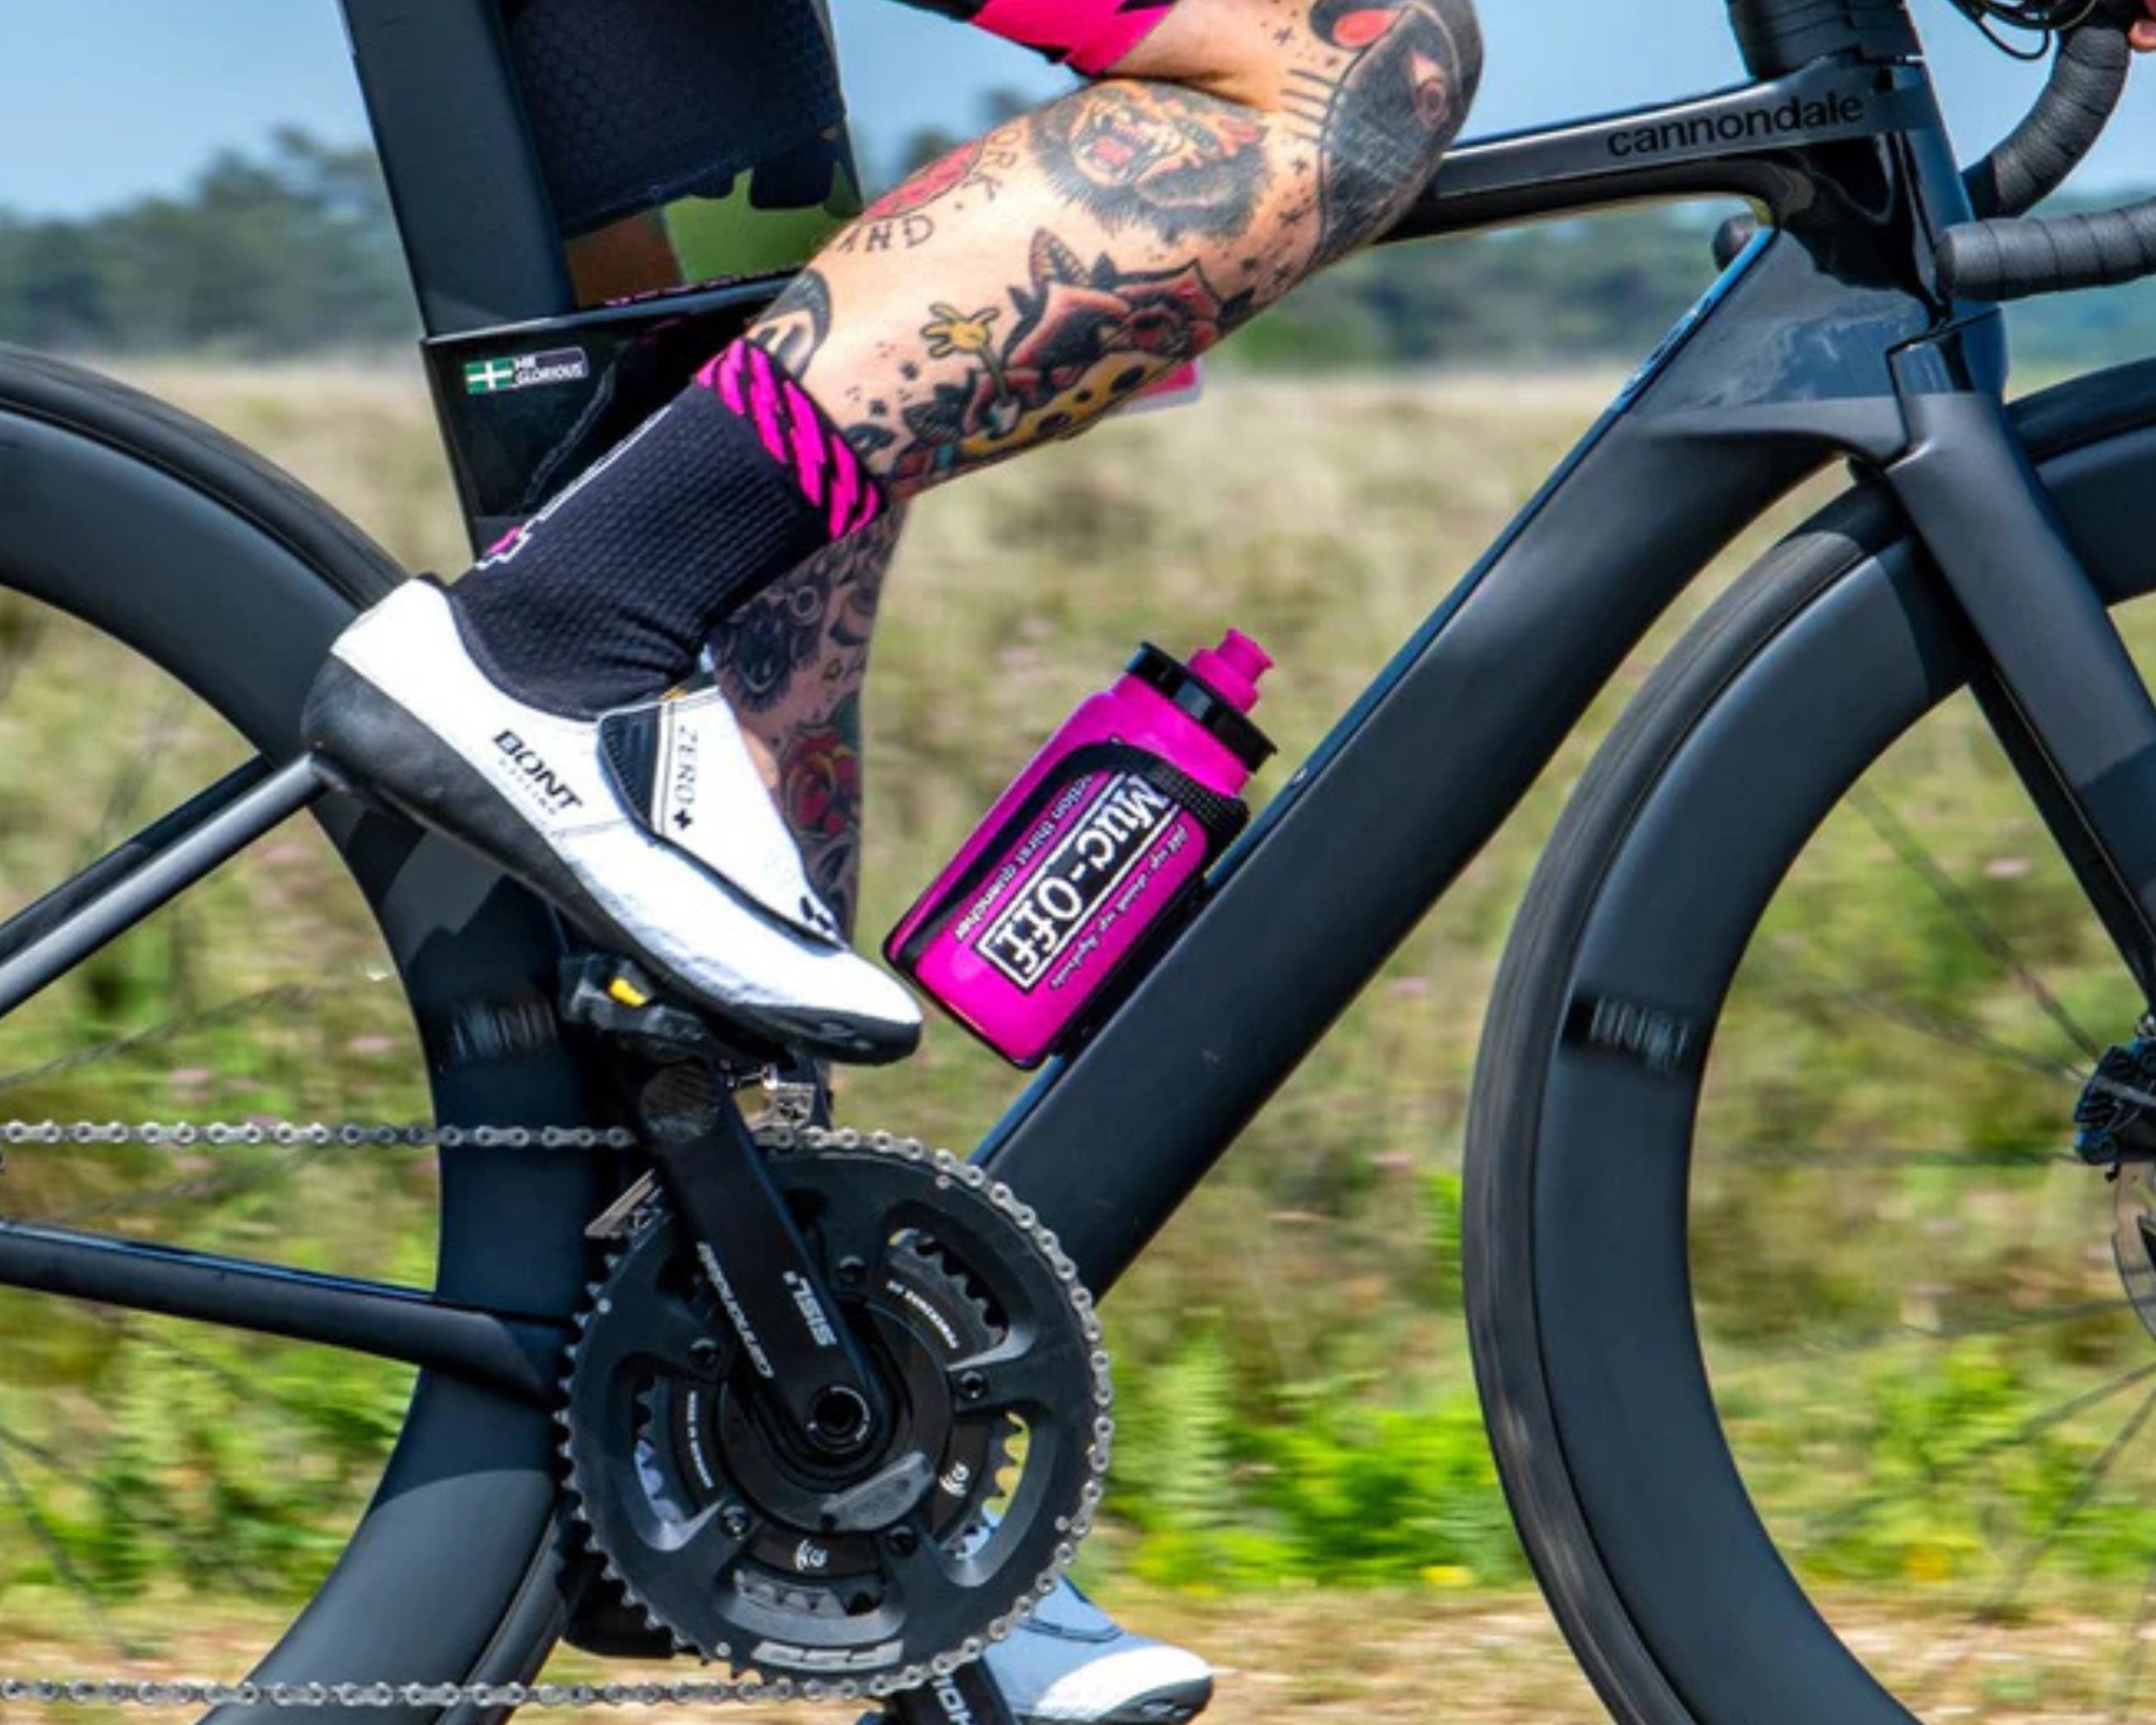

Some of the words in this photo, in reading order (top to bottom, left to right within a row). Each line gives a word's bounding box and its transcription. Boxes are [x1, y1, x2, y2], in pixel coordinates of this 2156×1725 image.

[1607, 91, 1864, 157] cannondale
[492, 730, 583, 809] BONT
[994, 775, 1171, 975] Muc-Off
[1015, 821, 1056, 865] thirst
[955, 863, 1017, 941] quencher
